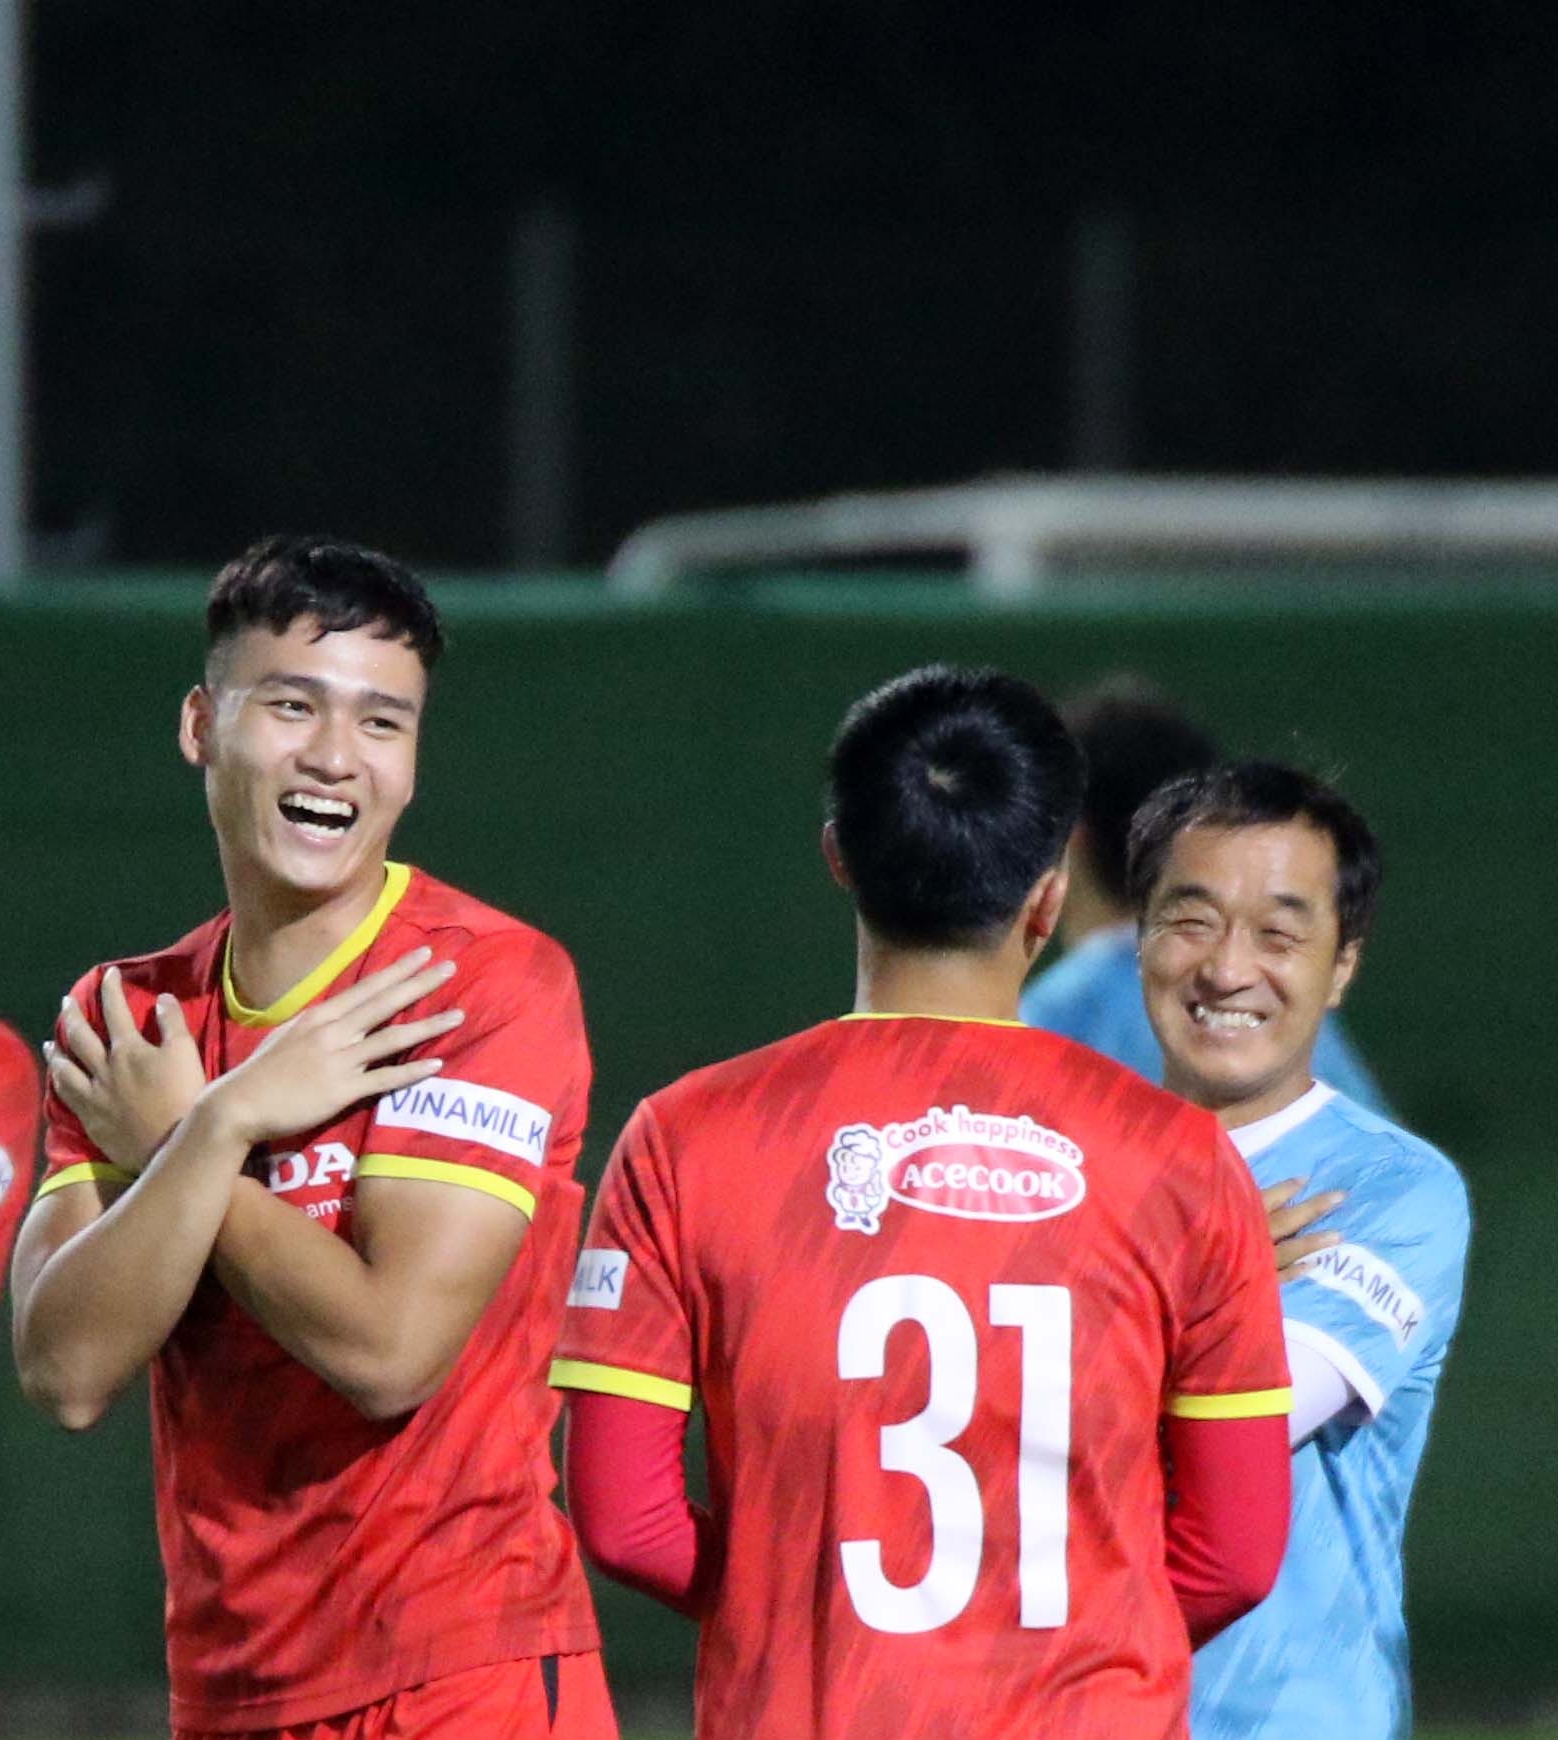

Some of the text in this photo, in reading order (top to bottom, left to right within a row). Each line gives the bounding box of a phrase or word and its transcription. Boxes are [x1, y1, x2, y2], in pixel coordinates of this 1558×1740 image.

[391, 1087, 545, 1150] VINAMILK
[886, 1112, 1078, 1160] Cook happiness
[837, 1274, 1071, 1634] 31
